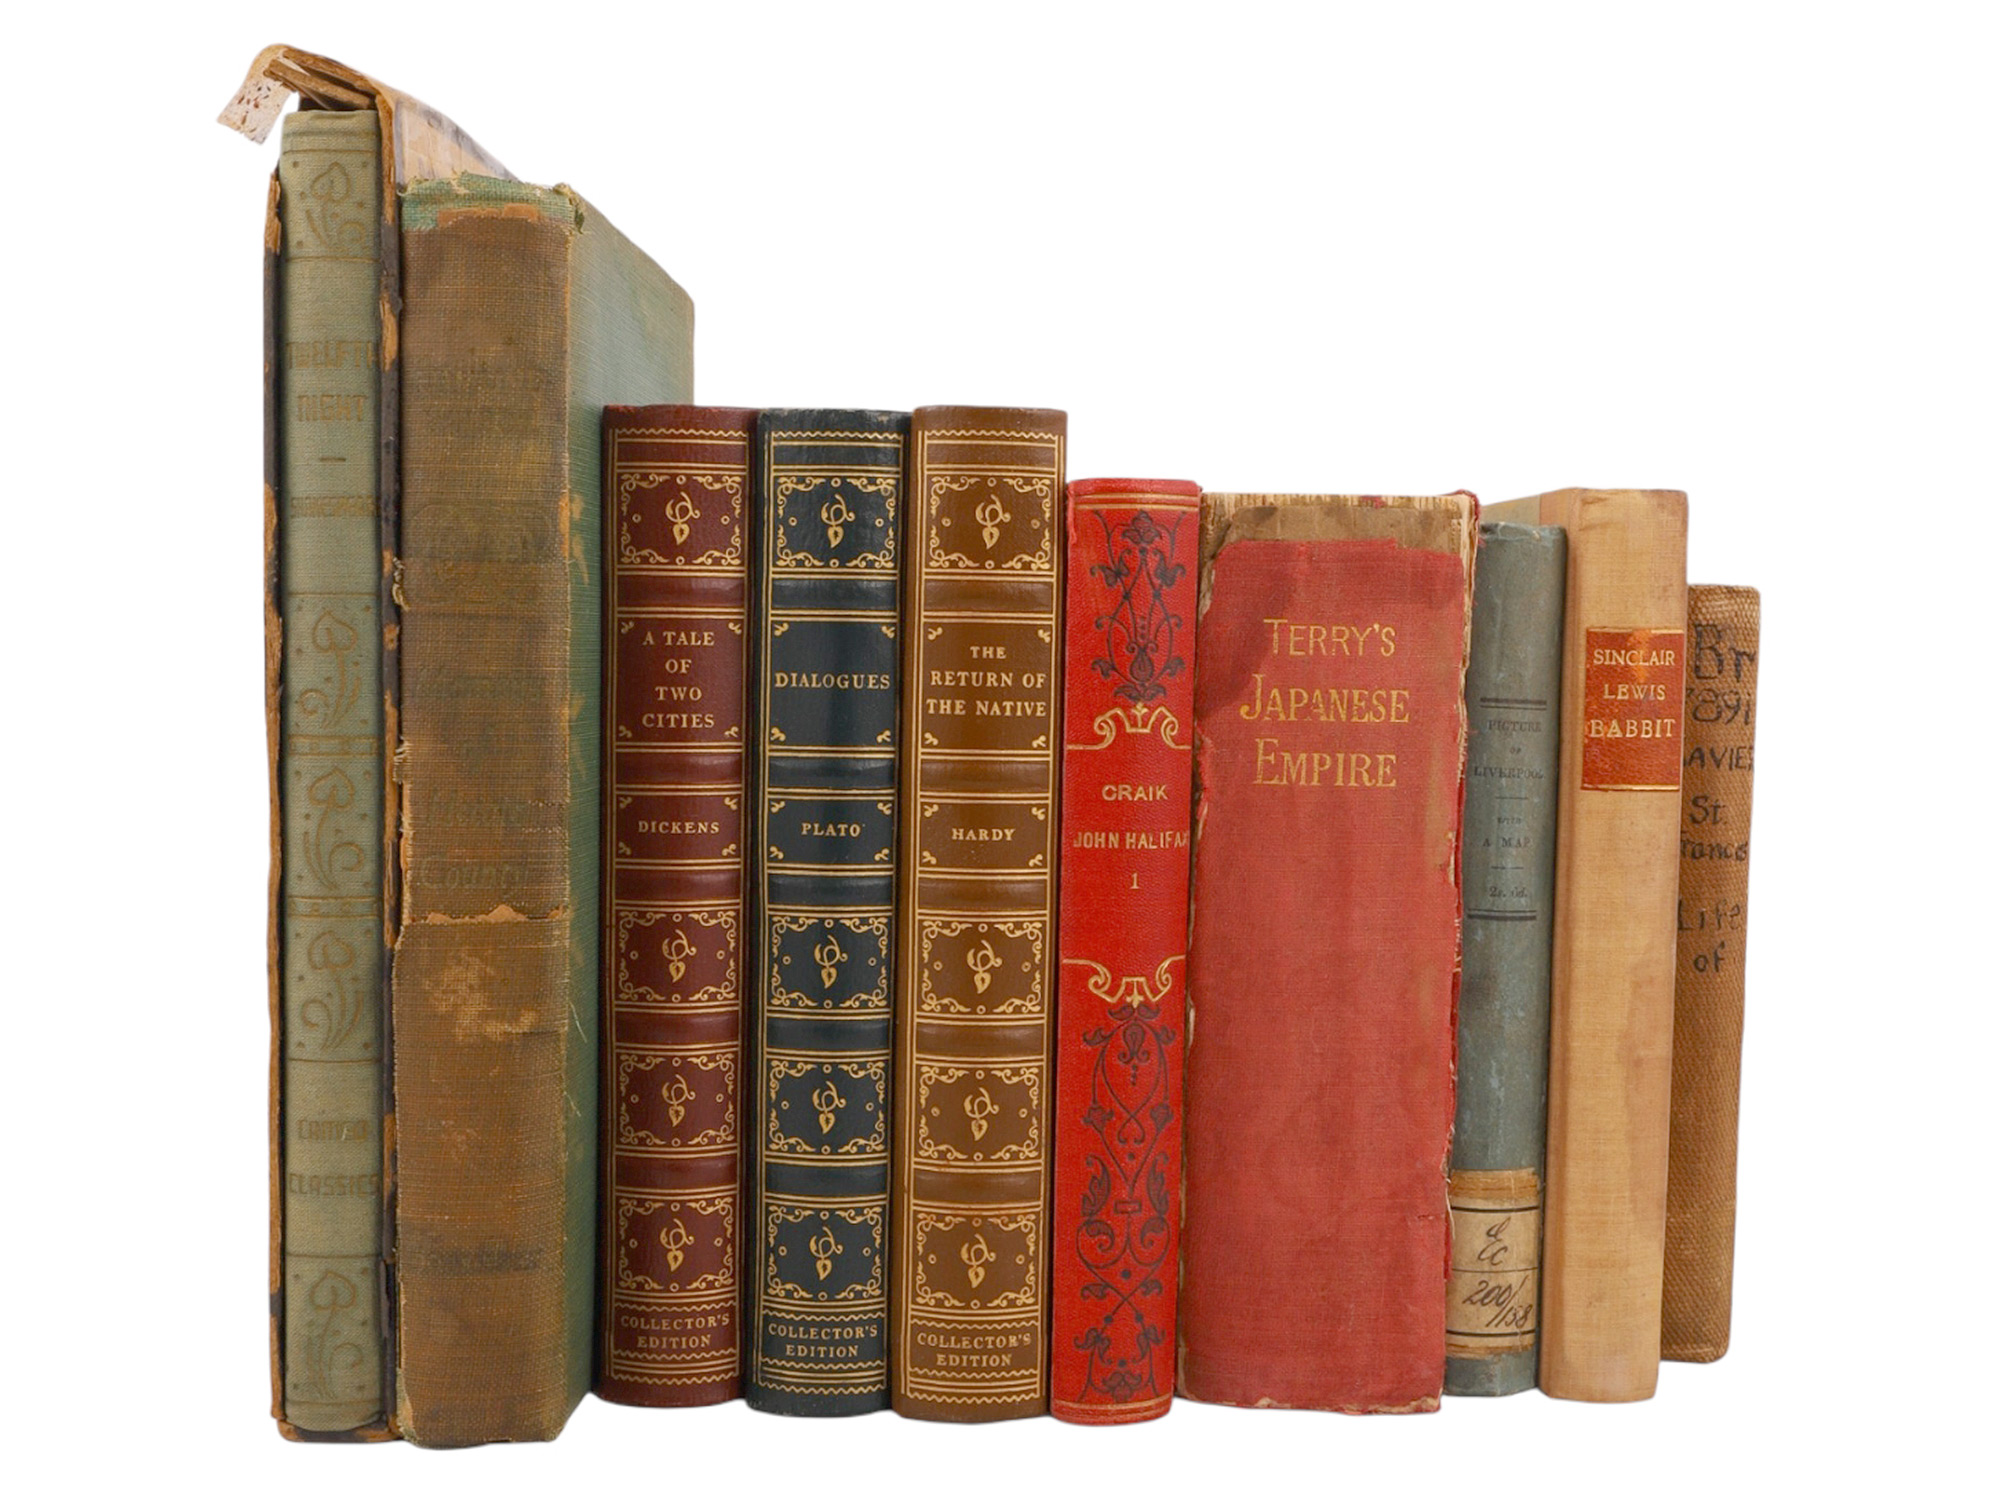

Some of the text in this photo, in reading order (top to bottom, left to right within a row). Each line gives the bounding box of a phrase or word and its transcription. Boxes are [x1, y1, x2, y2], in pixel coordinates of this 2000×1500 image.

[297, 393, 368, 422] NIGHT
[642, 631, 715, 646] A TALE
[1263, 619, 1396, 657] TERRY'S
[970, 646, 1007, 660] THE
[1593, 648, 1675, 667] SINCLAIR
[1693, 624, 1756, 683] Br
[665, 659, 692, 674] OF
[774, 672, 891, 690] DIALOGUES
[930, 670, 1047, 689] RETURN OF
[655, 686, 702, 701] TWO
[1239, 673, 1410, 723] JAPANESE
[1603, 683, 1666, 701] LEWIS
[926, 699, 1047, 717] THE NATIVE
[642, 713, 715, 729] CITIES
[1488, 720, 1542, 733] PICTURE
[1590, 718, 1676, 738] BABBIT
[1252, 738, 1397, 788] EMPIRE
[1683, 746, 1754, 771] AVIE
[1474, 766, 1544, 780] LIVERPOOL
[1101, 784, 1169, 801] CRAIK
[638, 821, 720, 834] DICKENS
[801, 822, 862, 838] PLATO
[951, 828, 1016, 841] HARDY
[1073, 831, 1120, 849] JOHN
[1482, 836, 1530, 848] A MAP
[1130, 872, 1140, 889] 1
[1693, 940, 1726, 973] of
[287, 1173, 379, 1197] CLASSICS
[620, 1313, 729, 1330] COLLECTOR'S
[768, 1323, 878, 1340] COLLECTOR'S
[637, 1334, 711, 1349] EDITION
[917, 1332, 1032, 1349] COLLECTOR'S
[786, 1345, 858, 1358] EDITION
[936, 1354, 1012, 1367] EDITION
